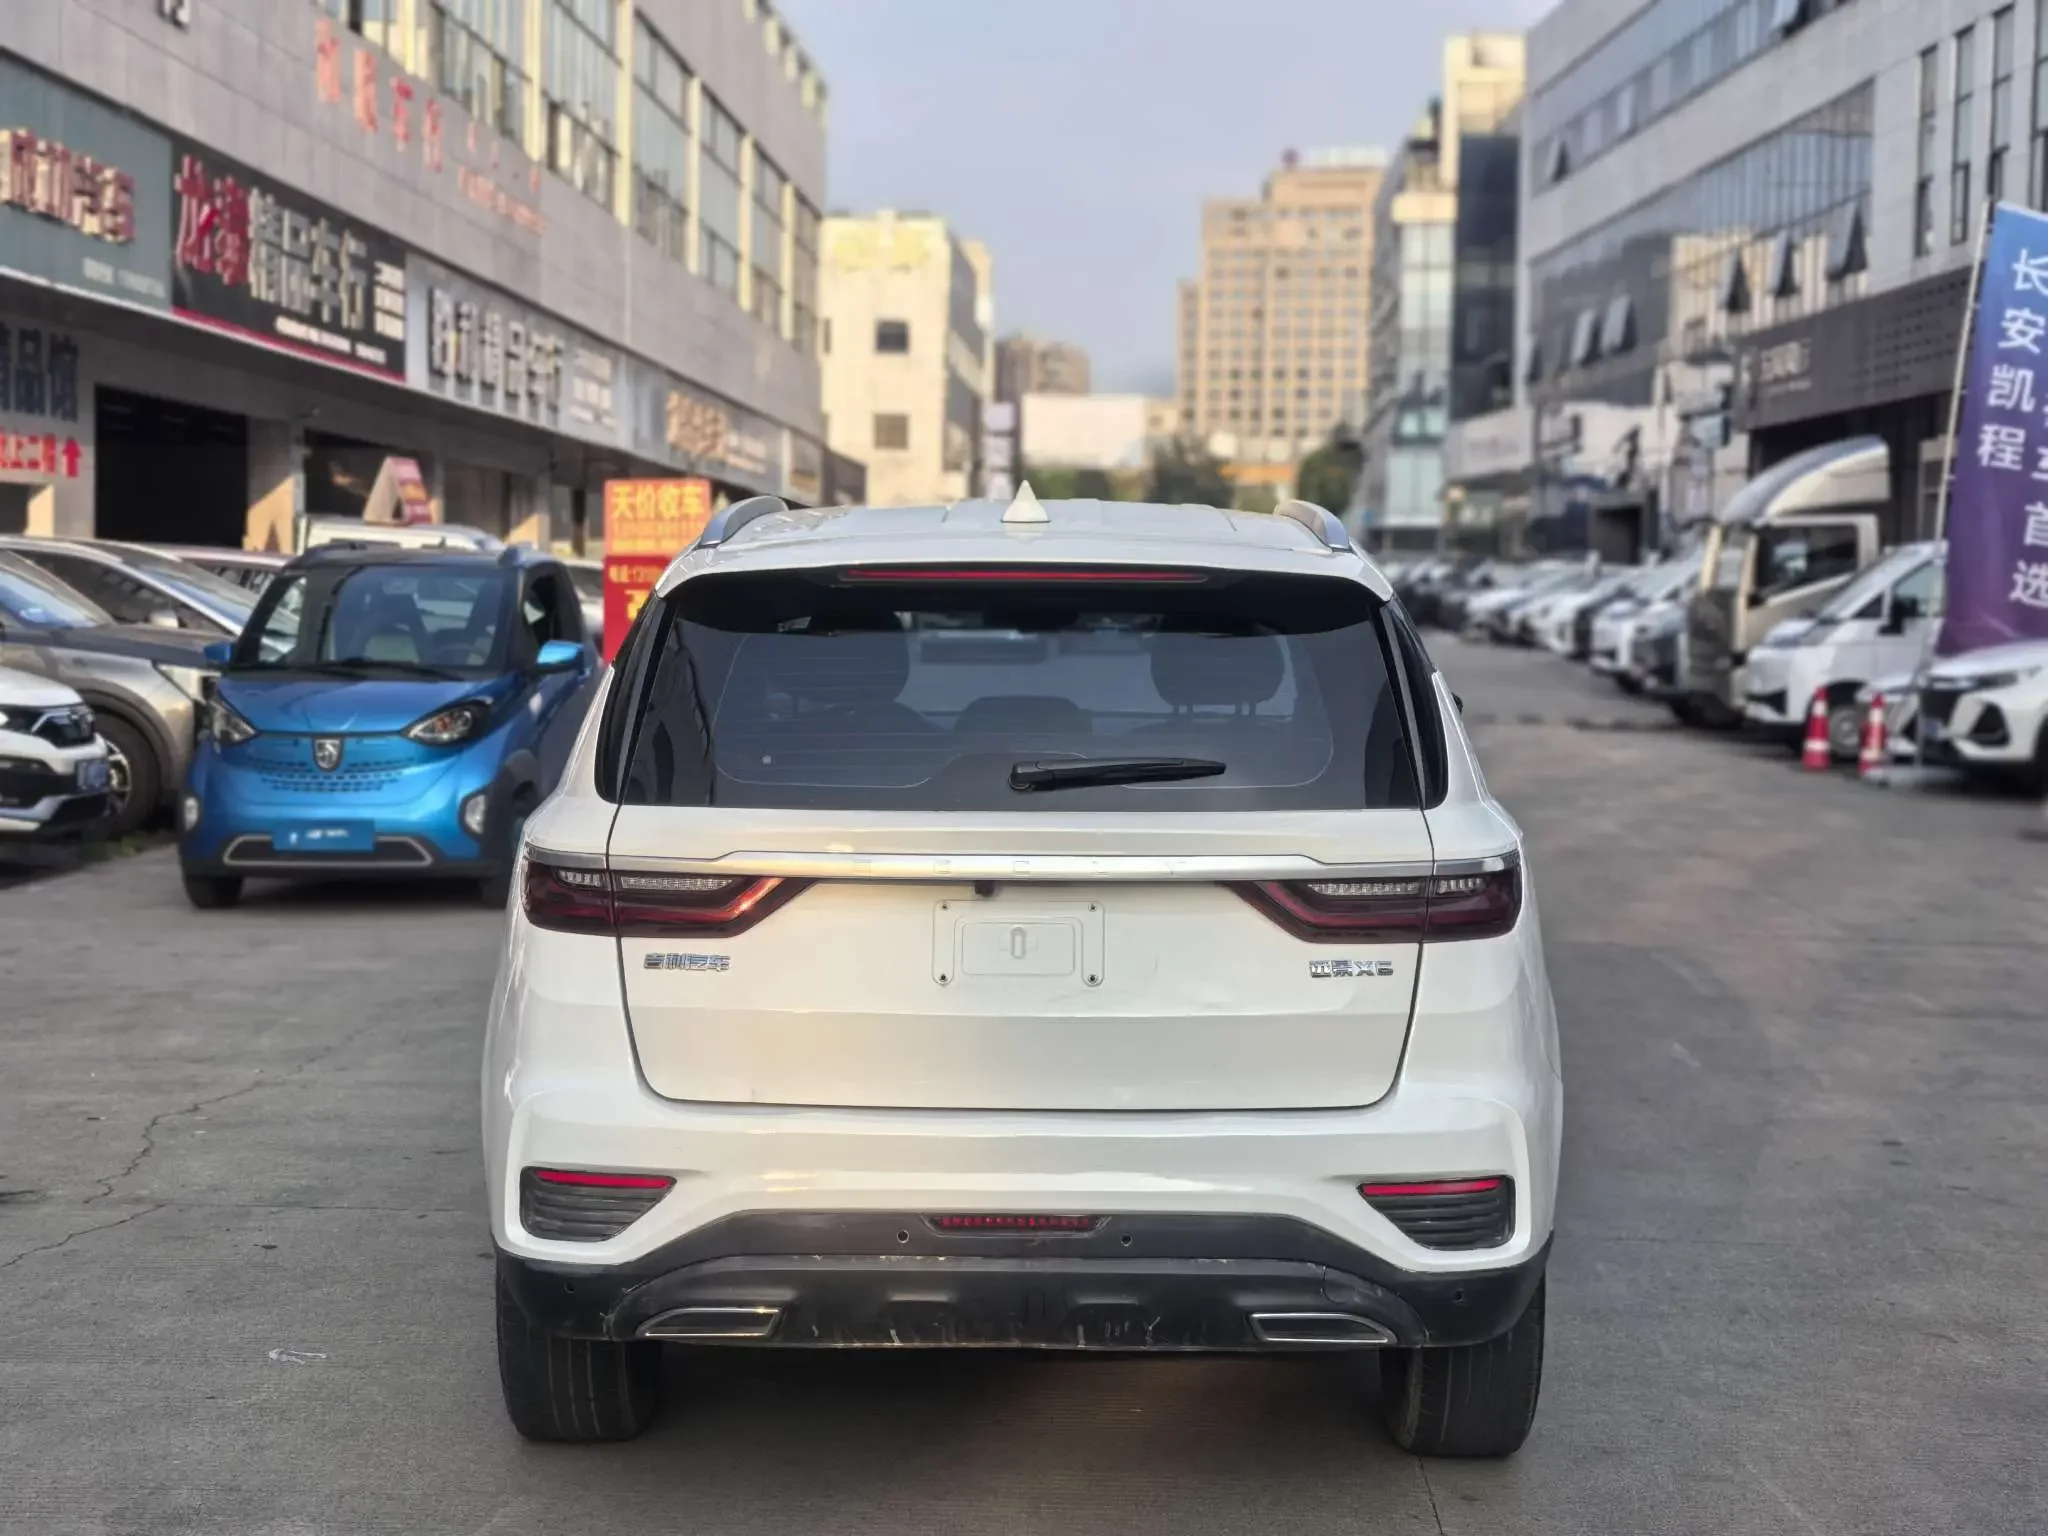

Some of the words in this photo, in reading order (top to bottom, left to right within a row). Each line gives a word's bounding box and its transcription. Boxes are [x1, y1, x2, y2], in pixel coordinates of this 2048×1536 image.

[1975, 247, 2048, 472] 长安凯程
[611, 482, 704, 520] 天价收车
